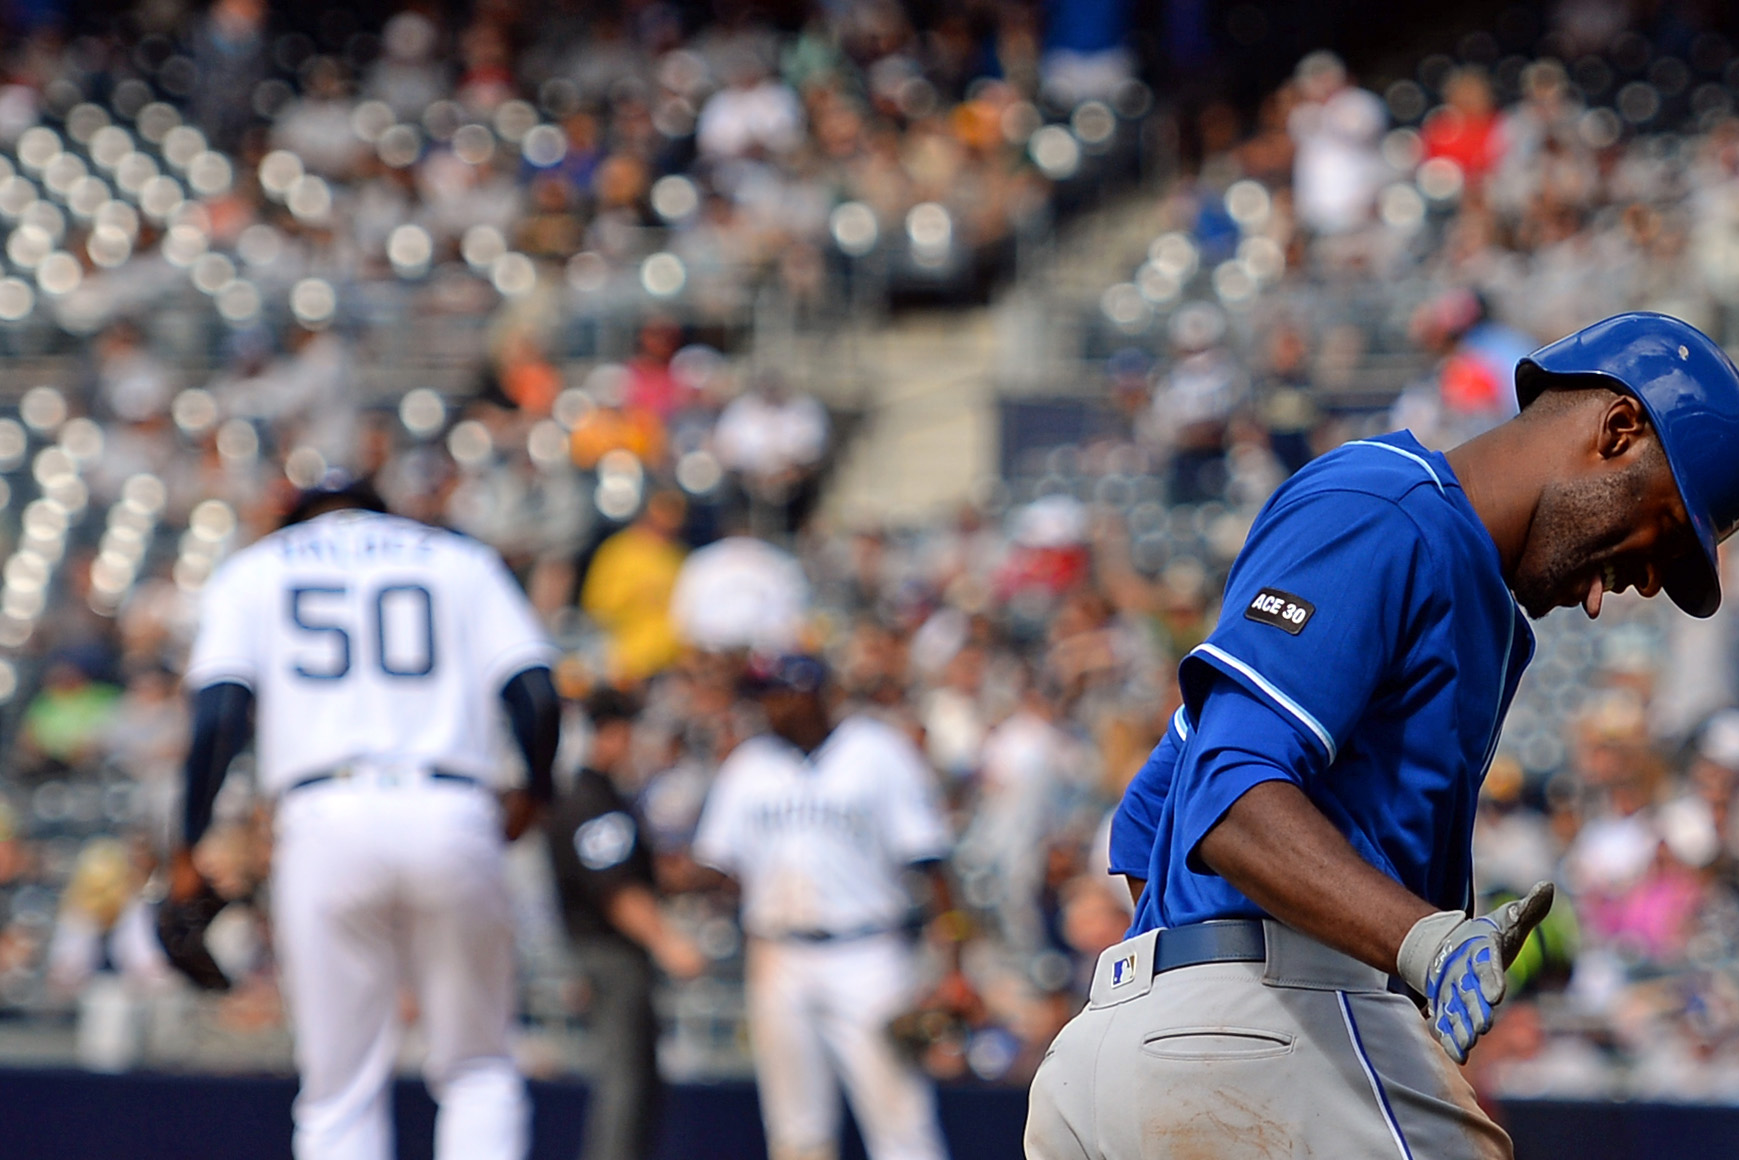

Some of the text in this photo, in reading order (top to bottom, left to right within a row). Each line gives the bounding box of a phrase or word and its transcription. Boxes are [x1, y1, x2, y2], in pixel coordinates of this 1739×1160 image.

[288, 580, 437, 681] 50
[1251, 593, 1306, 624] ACE 30
